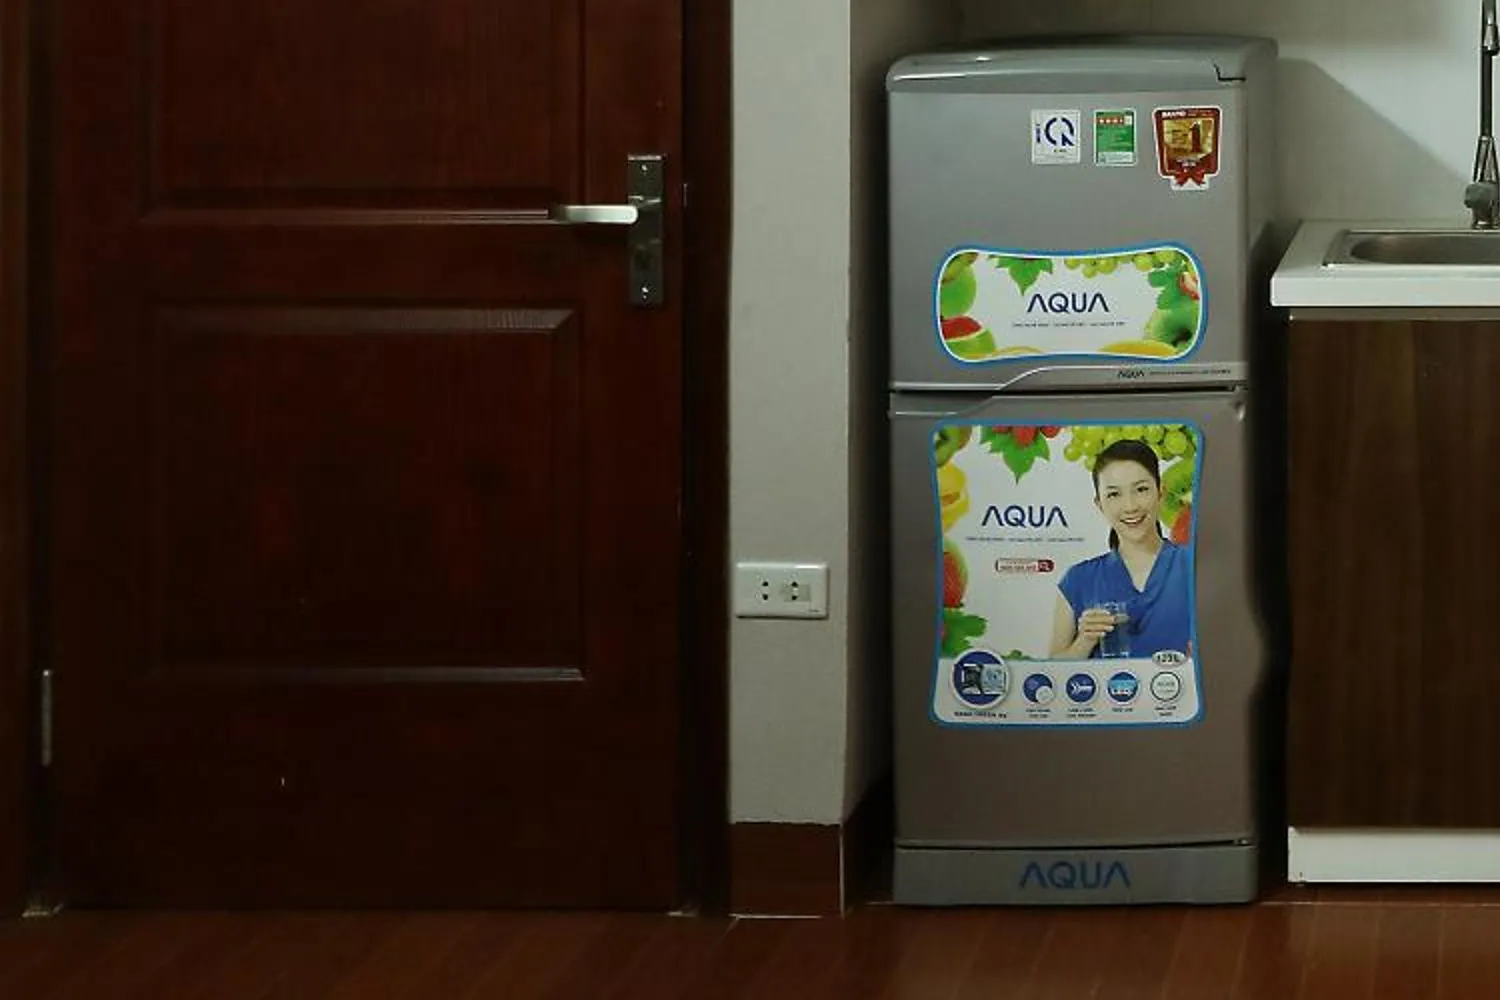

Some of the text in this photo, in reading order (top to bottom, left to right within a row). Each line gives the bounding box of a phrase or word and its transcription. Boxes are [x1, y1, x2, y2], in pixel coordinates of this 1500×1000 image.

[1027, 292, 1109, 314] AQUA
[981, 505, 1068, 528] AQUA
[1018, 861, 1132, 889] AQUA
